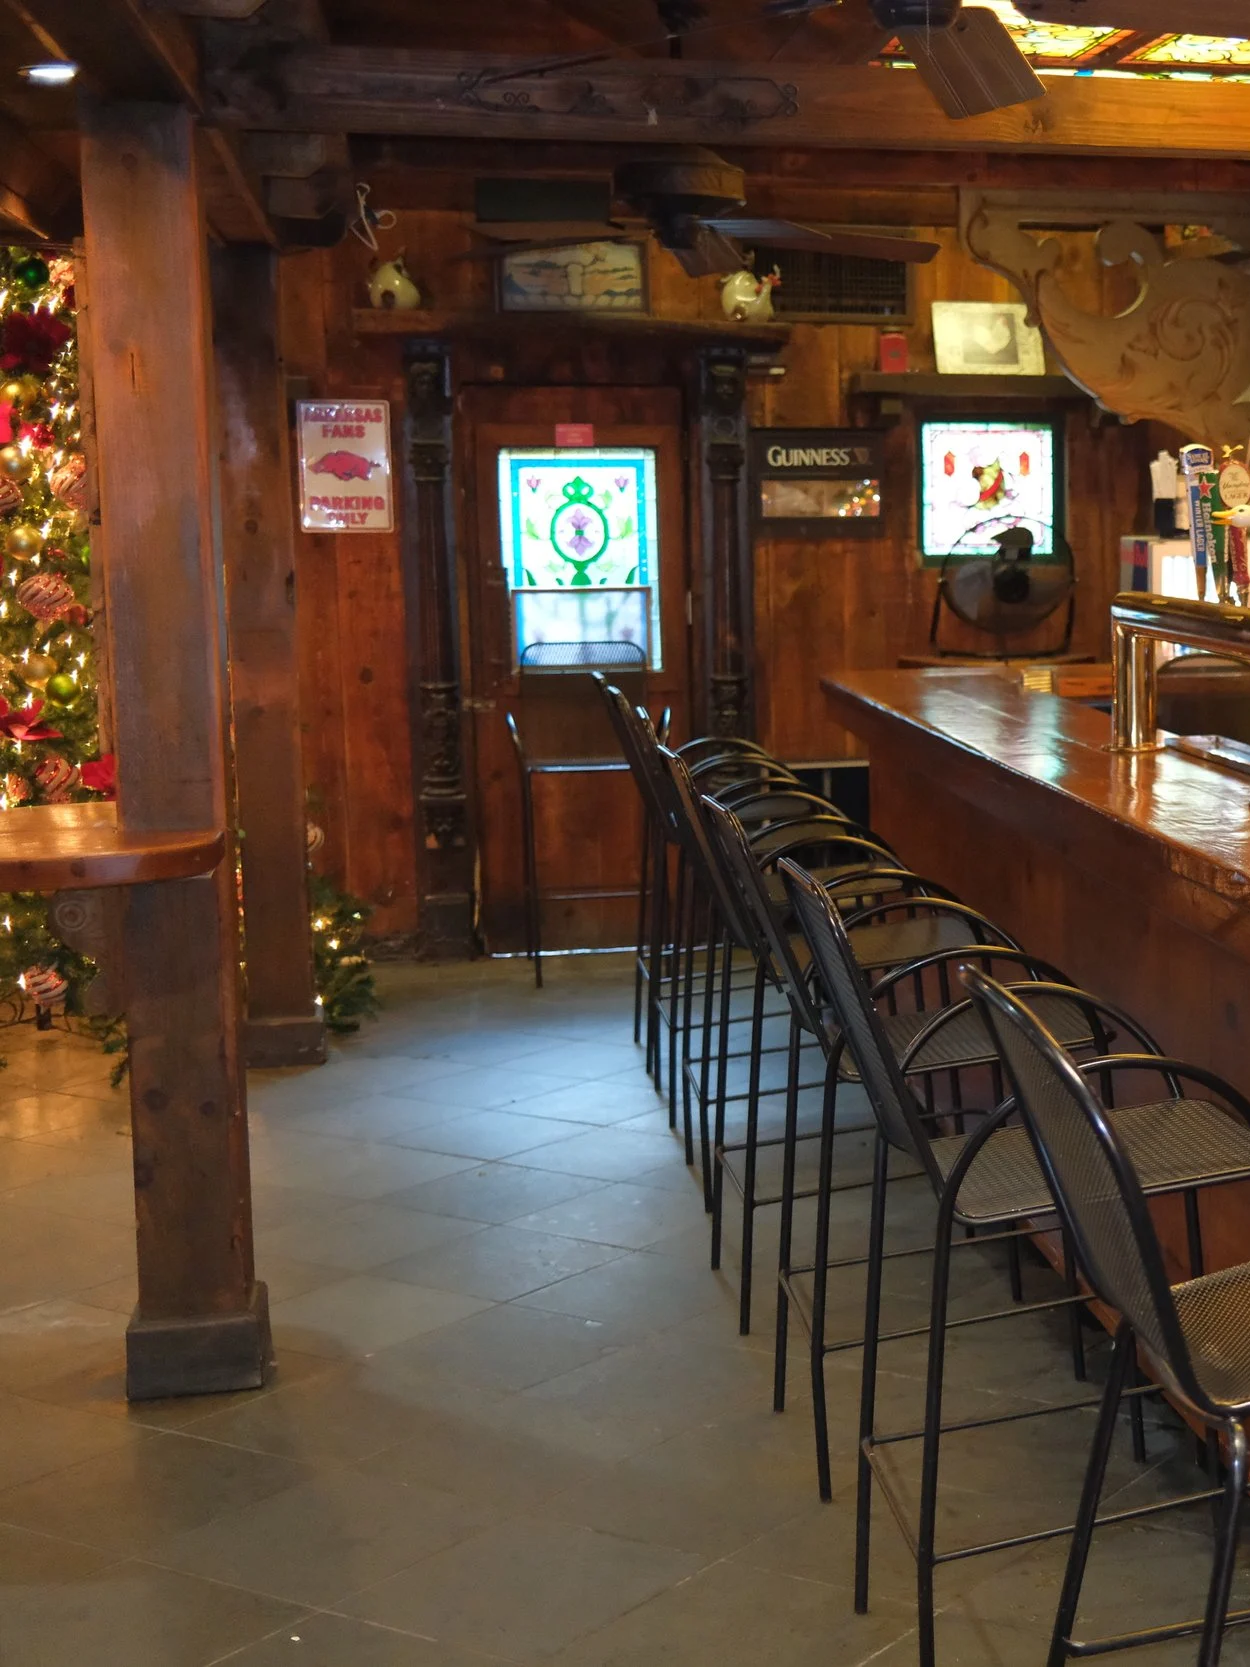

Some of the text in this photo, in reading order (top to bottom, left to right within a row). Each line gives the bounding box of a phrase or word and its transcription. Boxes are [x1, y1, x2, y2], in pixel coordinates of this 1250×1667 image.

[322, 425, 366, 438] FANS
[767, 446, 852, 467] GUINNESS
[309, 495, 385, 511] PARKING
[1202, 502, 1217, 562] Heineken
